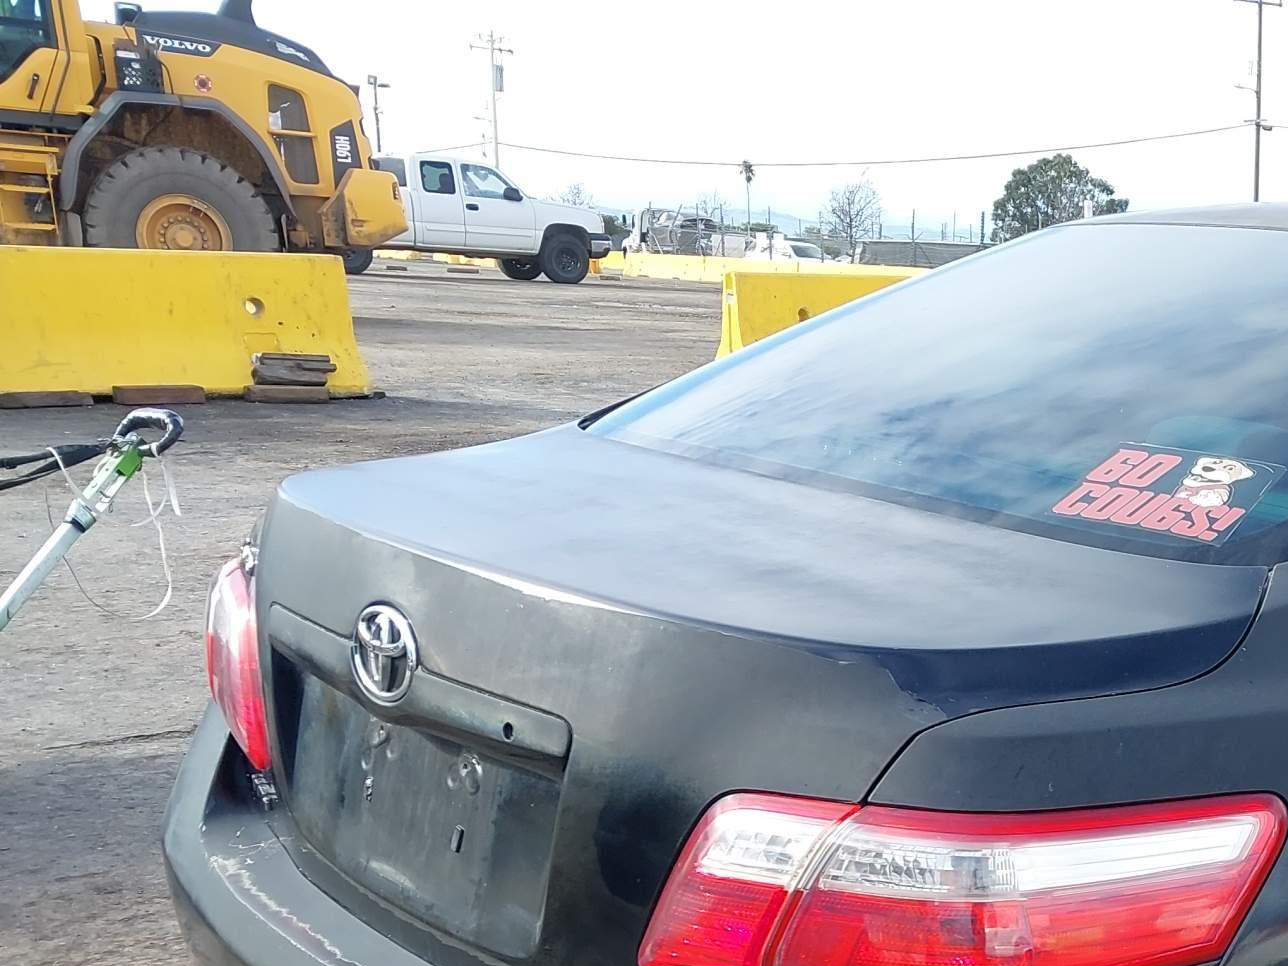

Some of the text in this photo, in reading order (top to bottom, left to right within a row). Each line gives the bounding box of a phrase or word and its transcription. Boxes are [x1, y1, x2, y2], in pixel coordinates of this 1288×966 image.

[143, 34, 211, 52] VOLVO
[335, 135, 352, 163] L90H
[1086, 448, 1182, 487] GO
[1052, 482, 1246, 541] COUGS!
